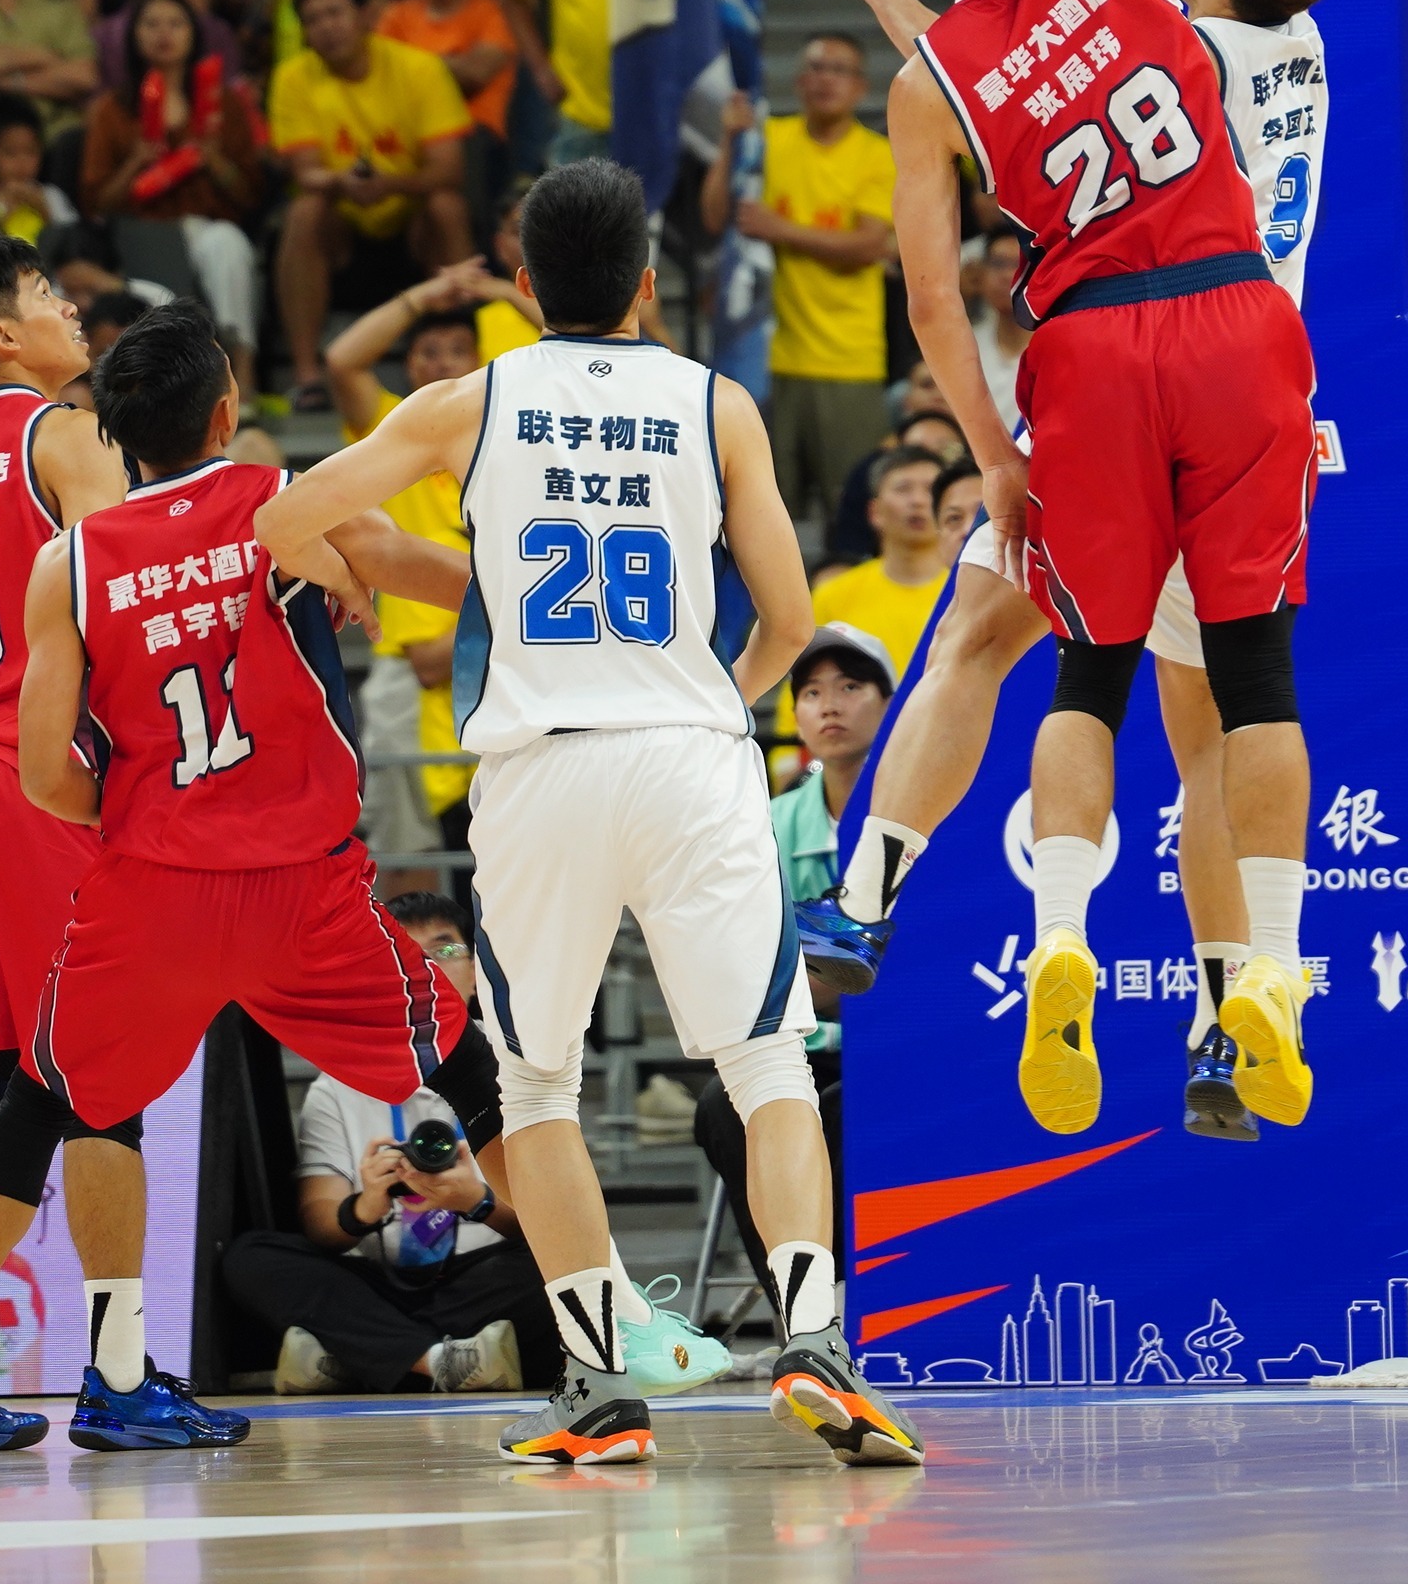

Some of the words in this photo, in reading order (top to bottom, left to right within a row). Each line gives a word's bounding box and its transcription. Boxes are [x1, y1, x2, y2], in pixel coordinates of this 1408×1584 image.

[1022, 24, 1123, 127] 张展玮
[1040, 62, 1205, 242] 28
[517, 409, 680, 456] 联宇物流
[544, 466, 651, 508] 黄文威
[519, 518, 677, 649] 28
[160, 654, 255, 791] 11
